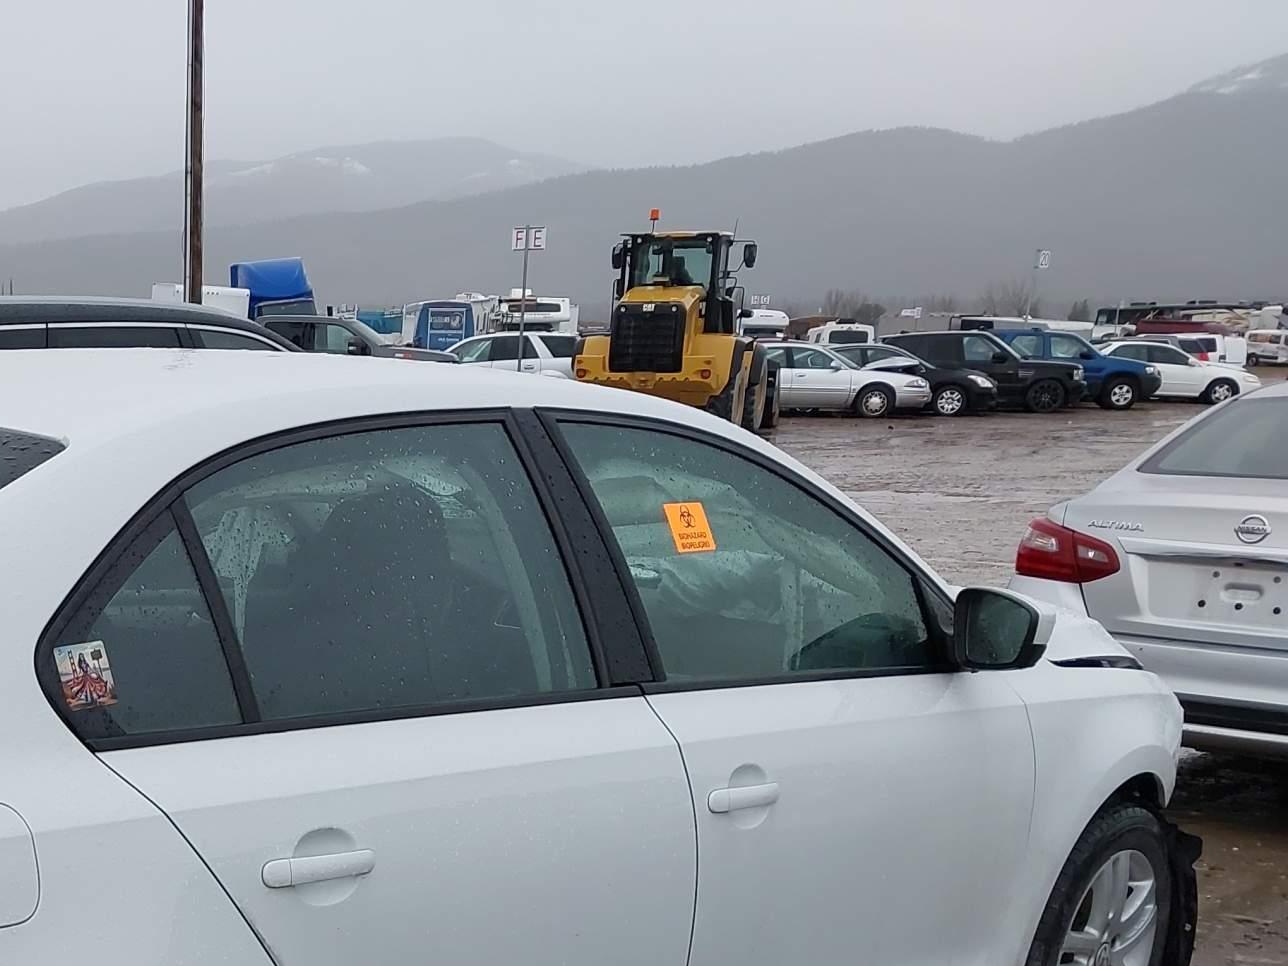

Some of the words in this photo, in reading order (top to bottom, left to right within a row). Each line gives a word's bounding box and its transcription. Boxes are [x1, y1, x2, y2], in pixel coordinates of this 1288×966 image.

[515, 230, 524, 248] F
[533, 230, 542, 247] E
[642, 303, 656, 312] CAT
[1088, 519, 1144, 532] ALTIMA
[1237, 525, 1268, 533] NISSAN
